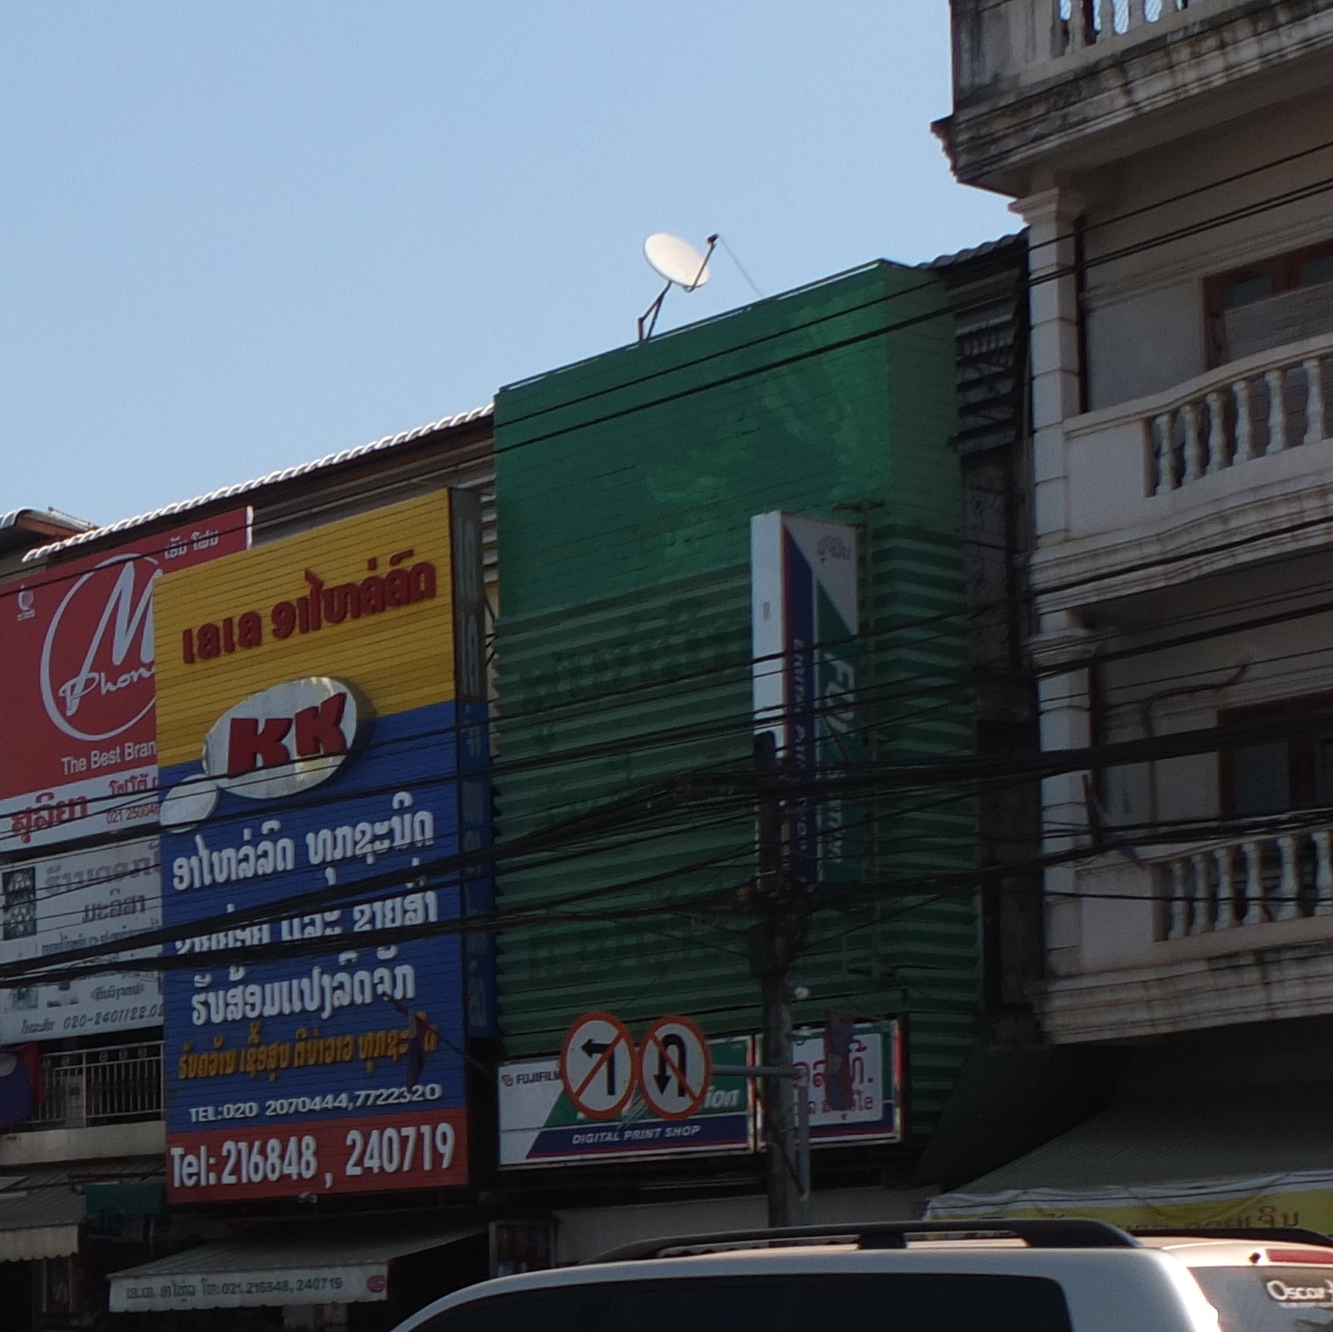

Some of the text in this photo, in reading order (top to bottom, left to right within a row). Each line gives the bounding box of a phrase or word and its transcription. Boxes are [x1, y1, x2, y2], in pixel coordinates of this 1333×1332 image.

[227, 691, 348, 777] KK
[61, 757, 87, 775] The
[90, 749, 121, 771] Best
[345, 1122, 456, 1176] 240719
[572, 1124, 701, 1145] DIGITAL PRINT SHOP
